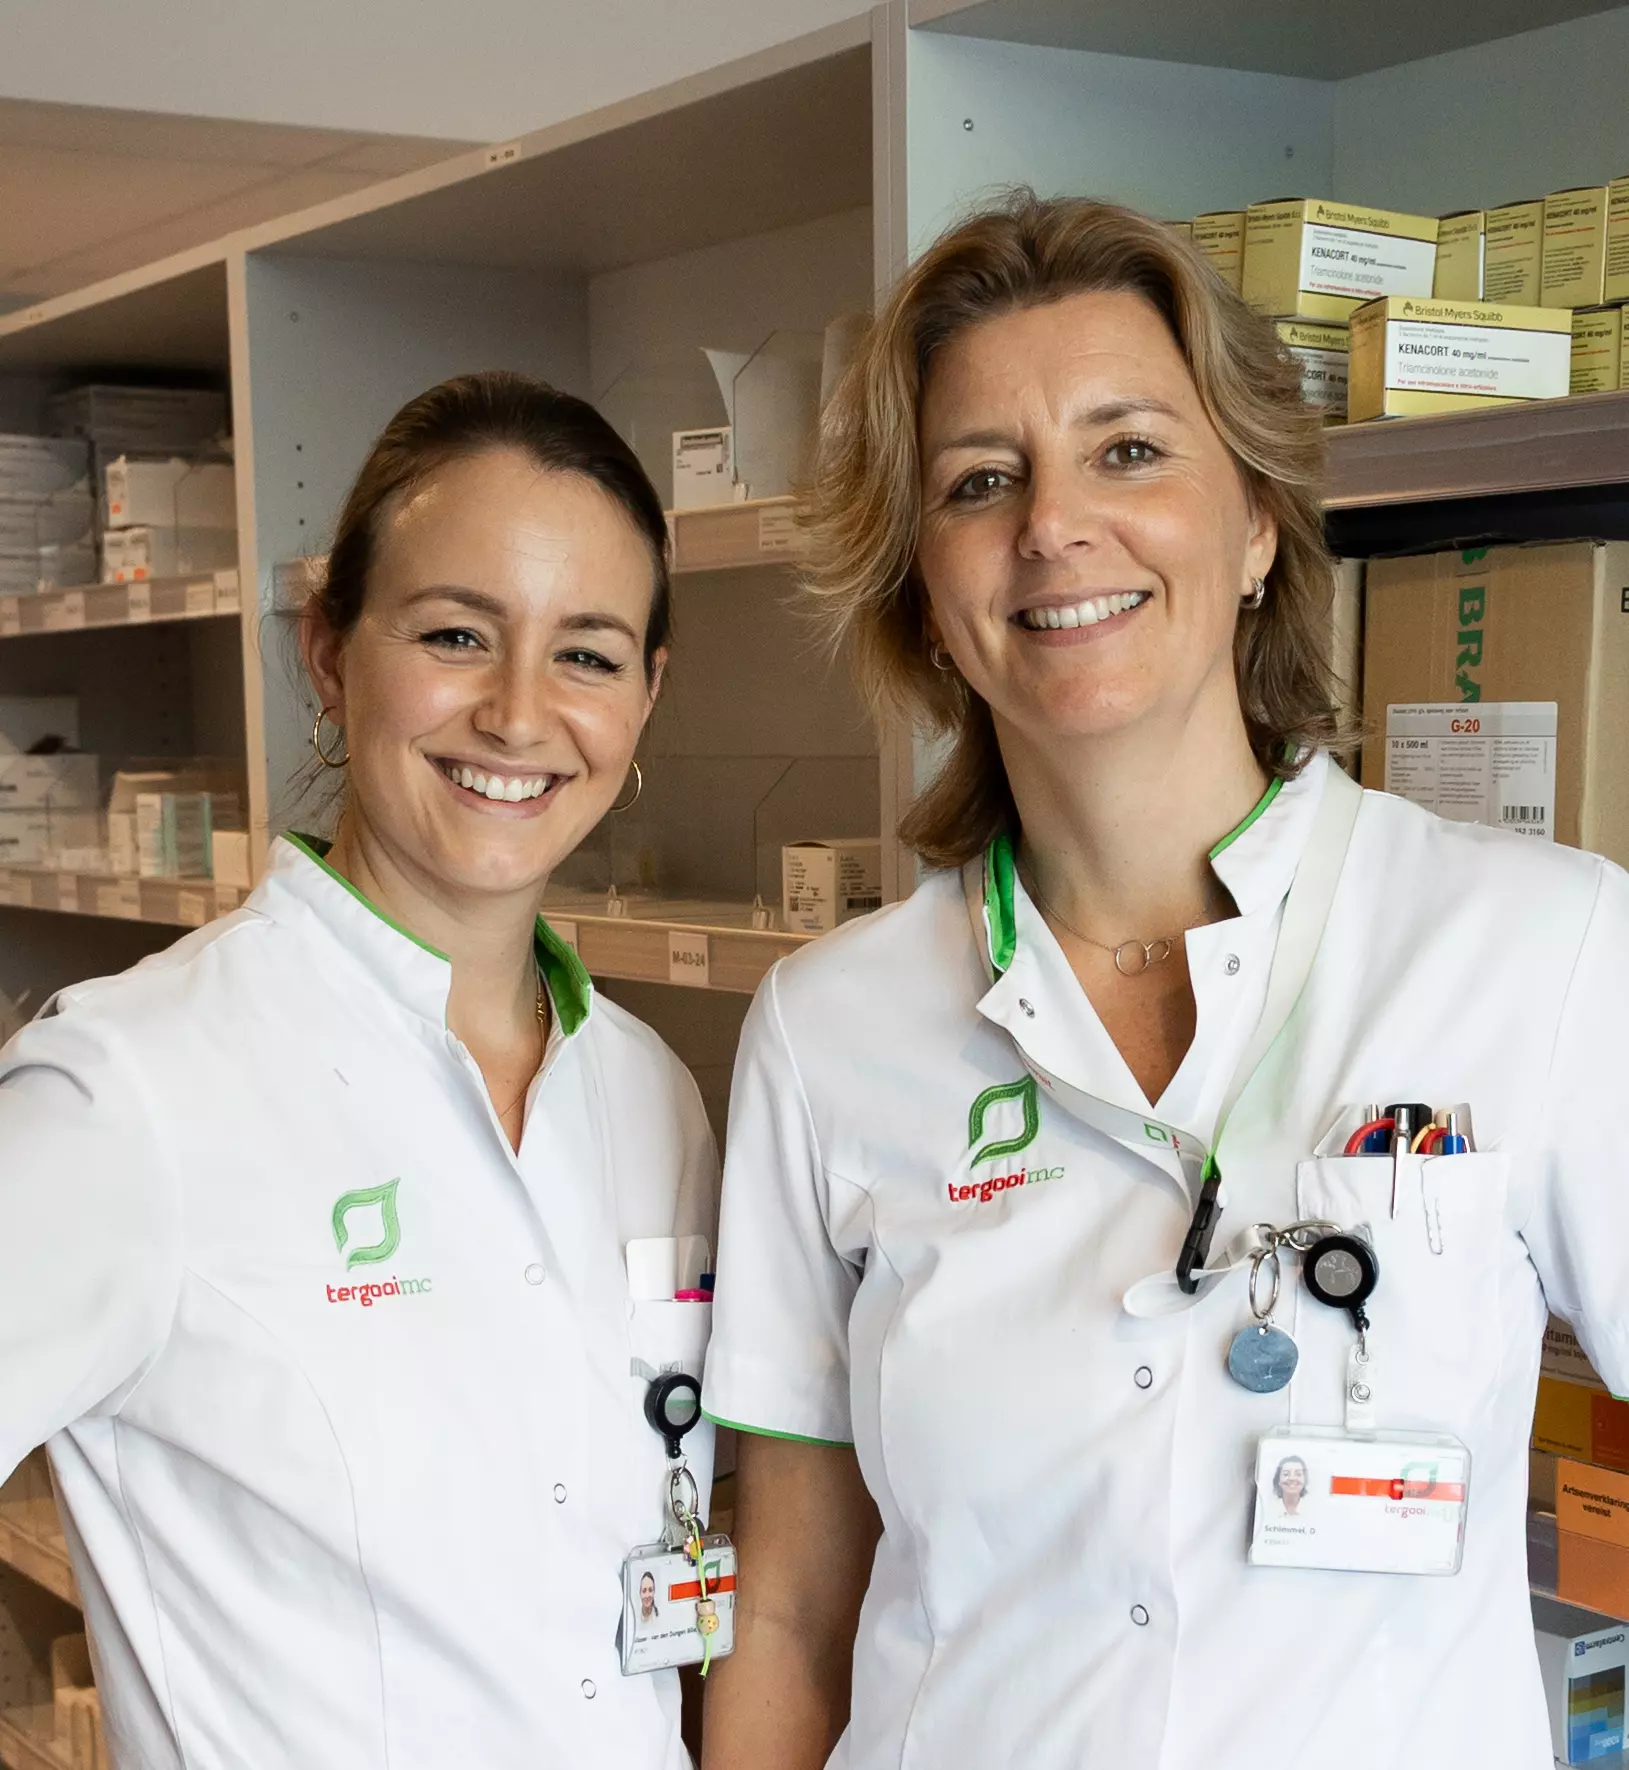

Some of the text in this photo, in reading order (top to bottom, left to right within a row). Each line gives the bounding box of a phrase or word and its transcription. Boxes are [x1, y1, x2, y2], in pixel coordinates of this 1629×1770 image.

[1311, 246, 1377, 267] KENACORT 40 mg/ml
[1415, 305, 1504, 323] Bristol Myers Squibb
[1398, 343, 1487, 361] KENACORT 40 mg/ml
[1398, 361, 1499, 380] Triamcinolone acetonide
[1451, 719, 1481, 733] G-20
[1391, 740, 1399, 749] 10
[1406, 740, 1419, 749] 500
[1420, 740, 1429, 749] ml
[947, 1166, 1065, 1203] tergooimc
[326, 1275, 432, 1307] tergooimc
